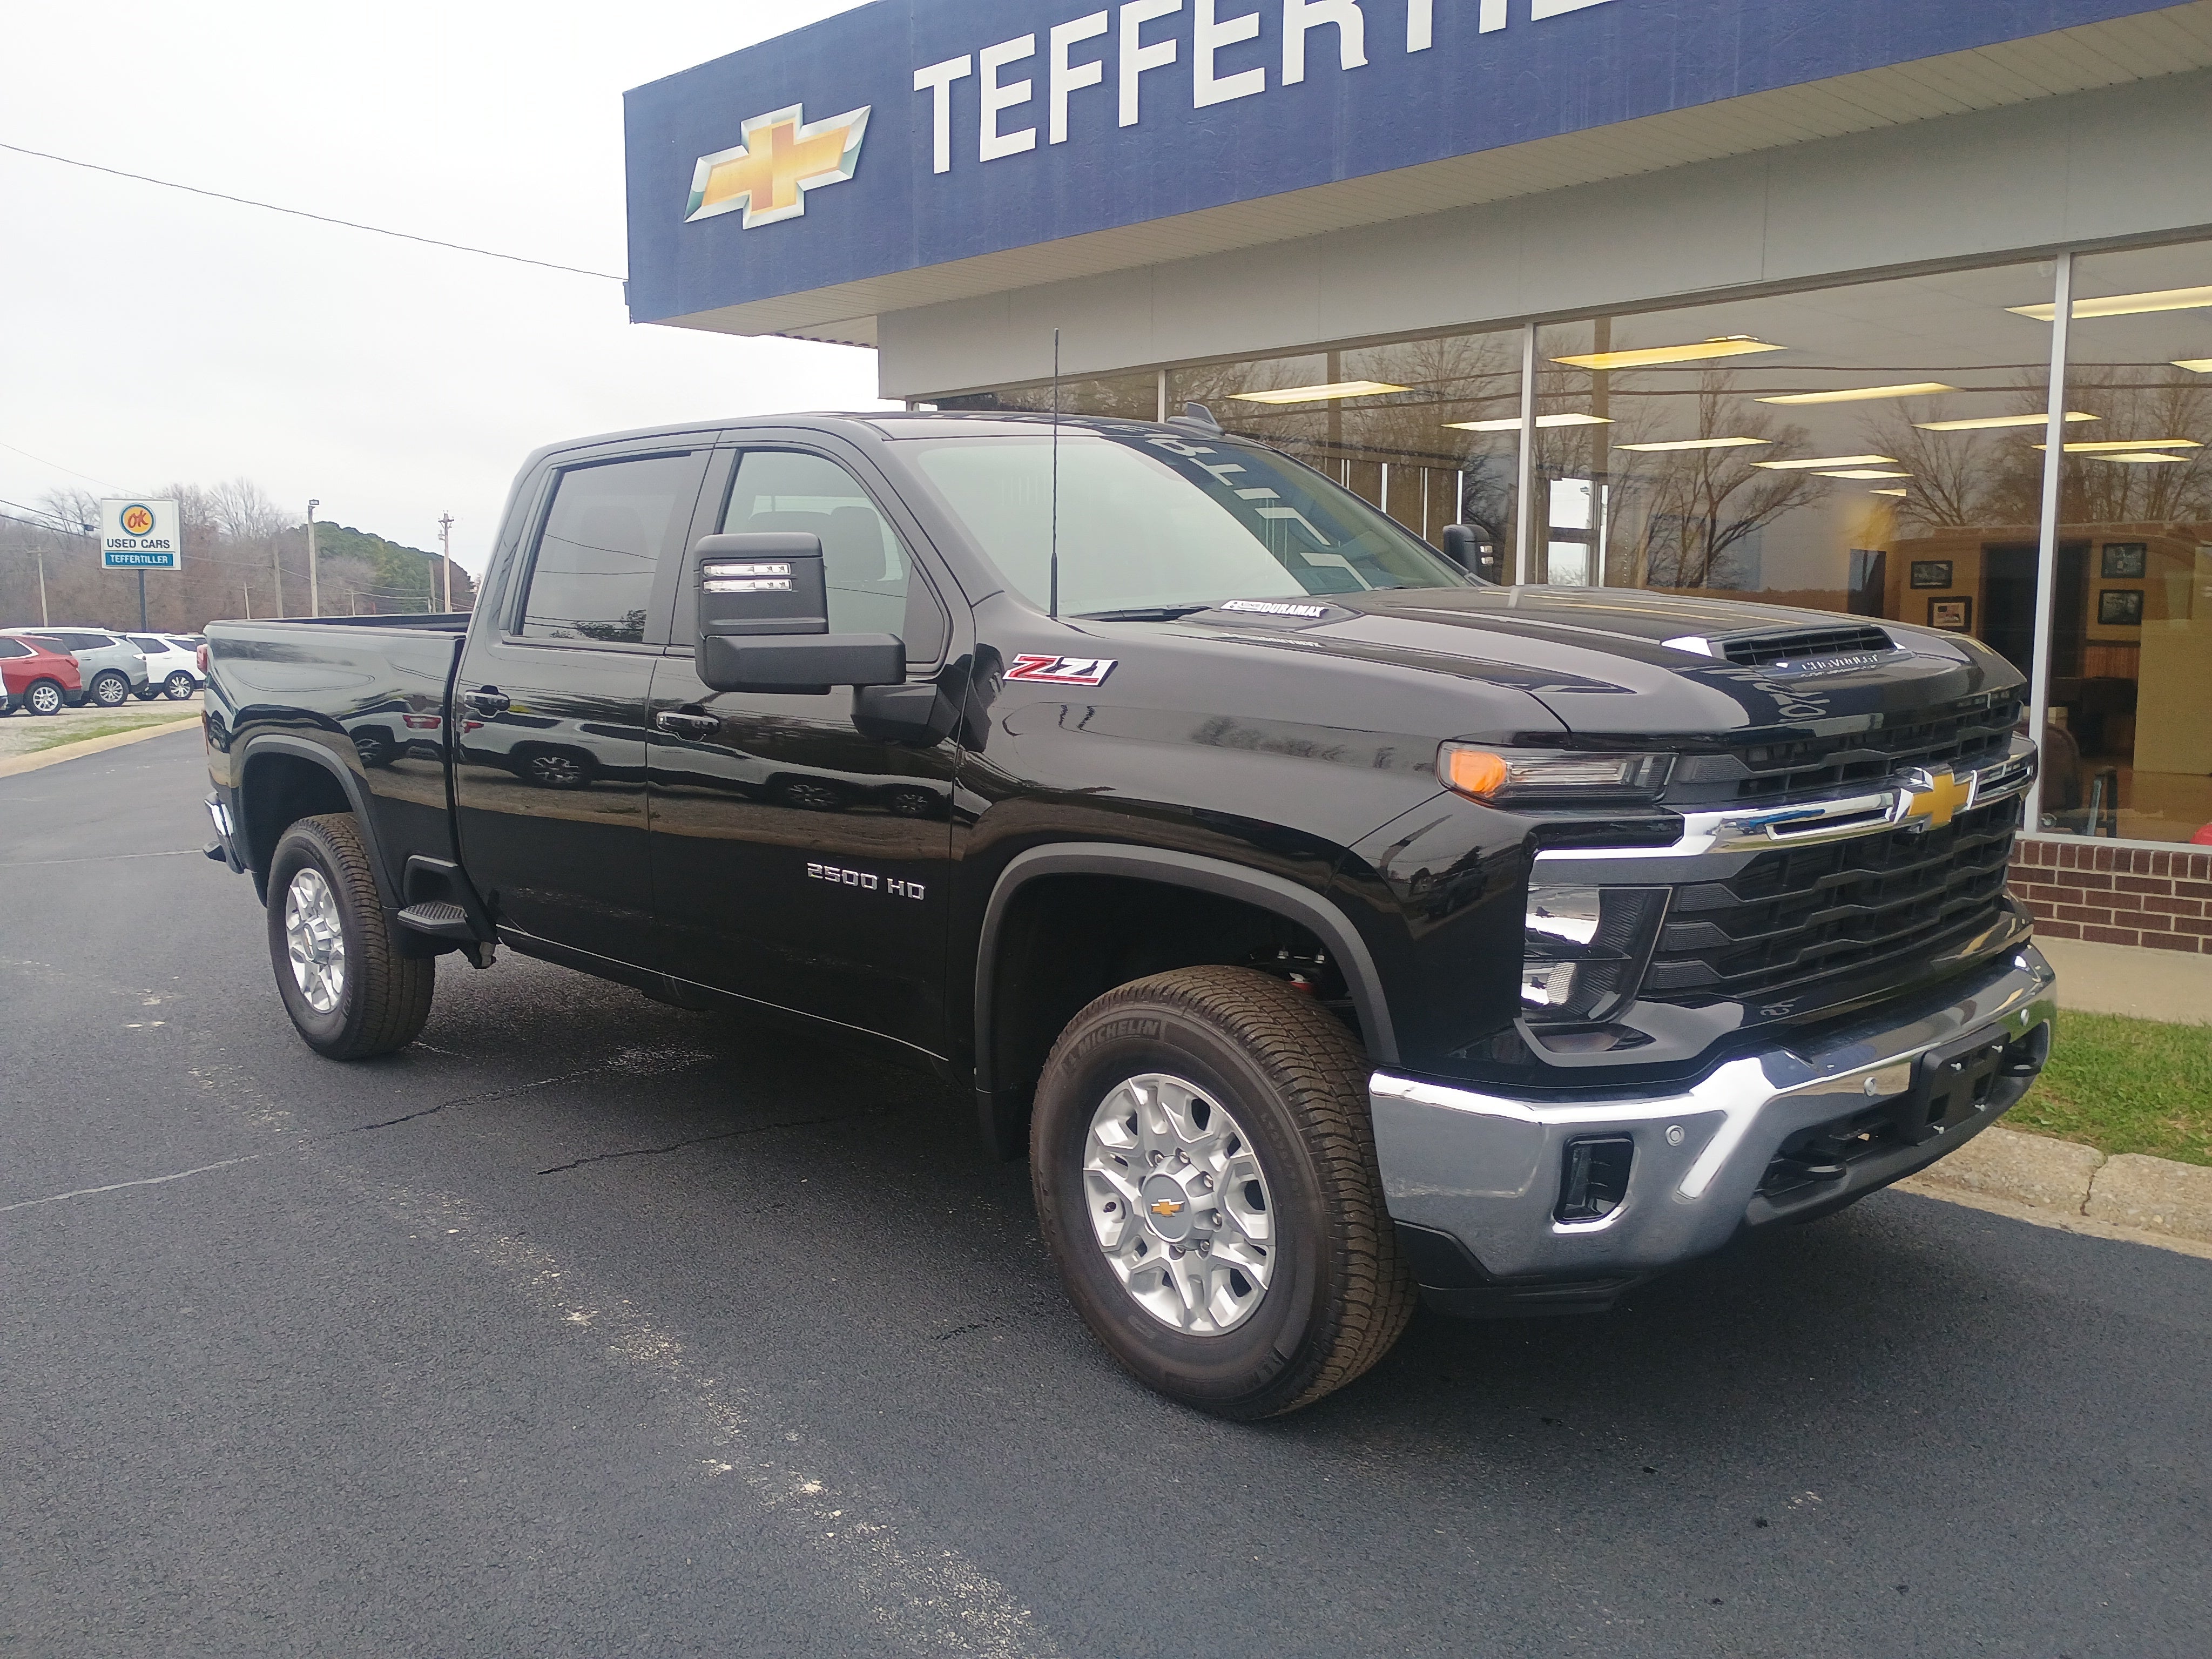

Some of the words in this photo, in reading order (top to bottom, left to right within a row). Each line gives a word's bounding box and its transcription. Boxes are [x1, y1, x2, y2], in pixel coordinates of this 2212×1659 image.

[913, 0, 1612, 174] TEFFER
[127, 510, 149, 528] OK
[107, 538, 136, 548] USED
[141, 539, 170, 549] CARS
[110, 554, 168, 563] TEFFERTILLER
[1260, 603, 1325, 617] DURAMAX
[1002, 653, 1118, 687] Z71
[807, 863, 879, 890] 2500
[887, 878, 926, 900] HD
